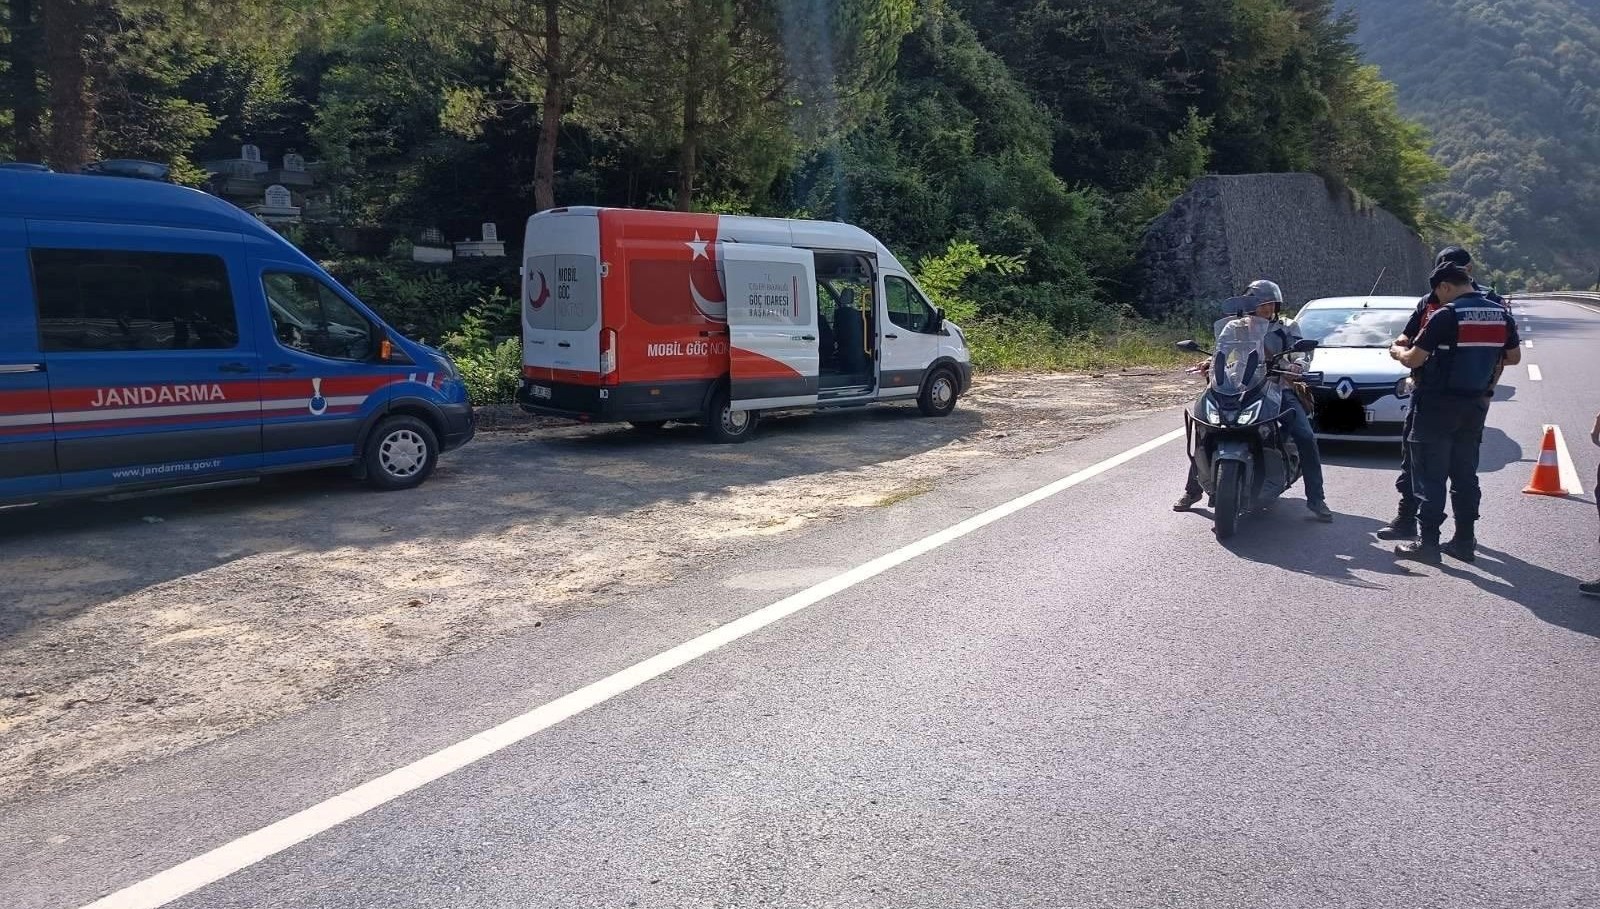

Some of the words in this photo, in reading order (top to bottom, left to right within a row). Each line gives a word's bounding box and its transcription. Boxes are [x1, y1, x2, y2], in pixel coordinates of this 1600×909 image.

[749, 292, 762, 308] GÖÇ
[1463, 311, 1504, 321] JANDARMA
[647, 341, 684, 357] MOBİL
[686, 341, 709, 357] GÖÇ
[91, 384, 225, 407] JANDARMA
[112, 459, 221, 478] www.jandarma.gov.tr
